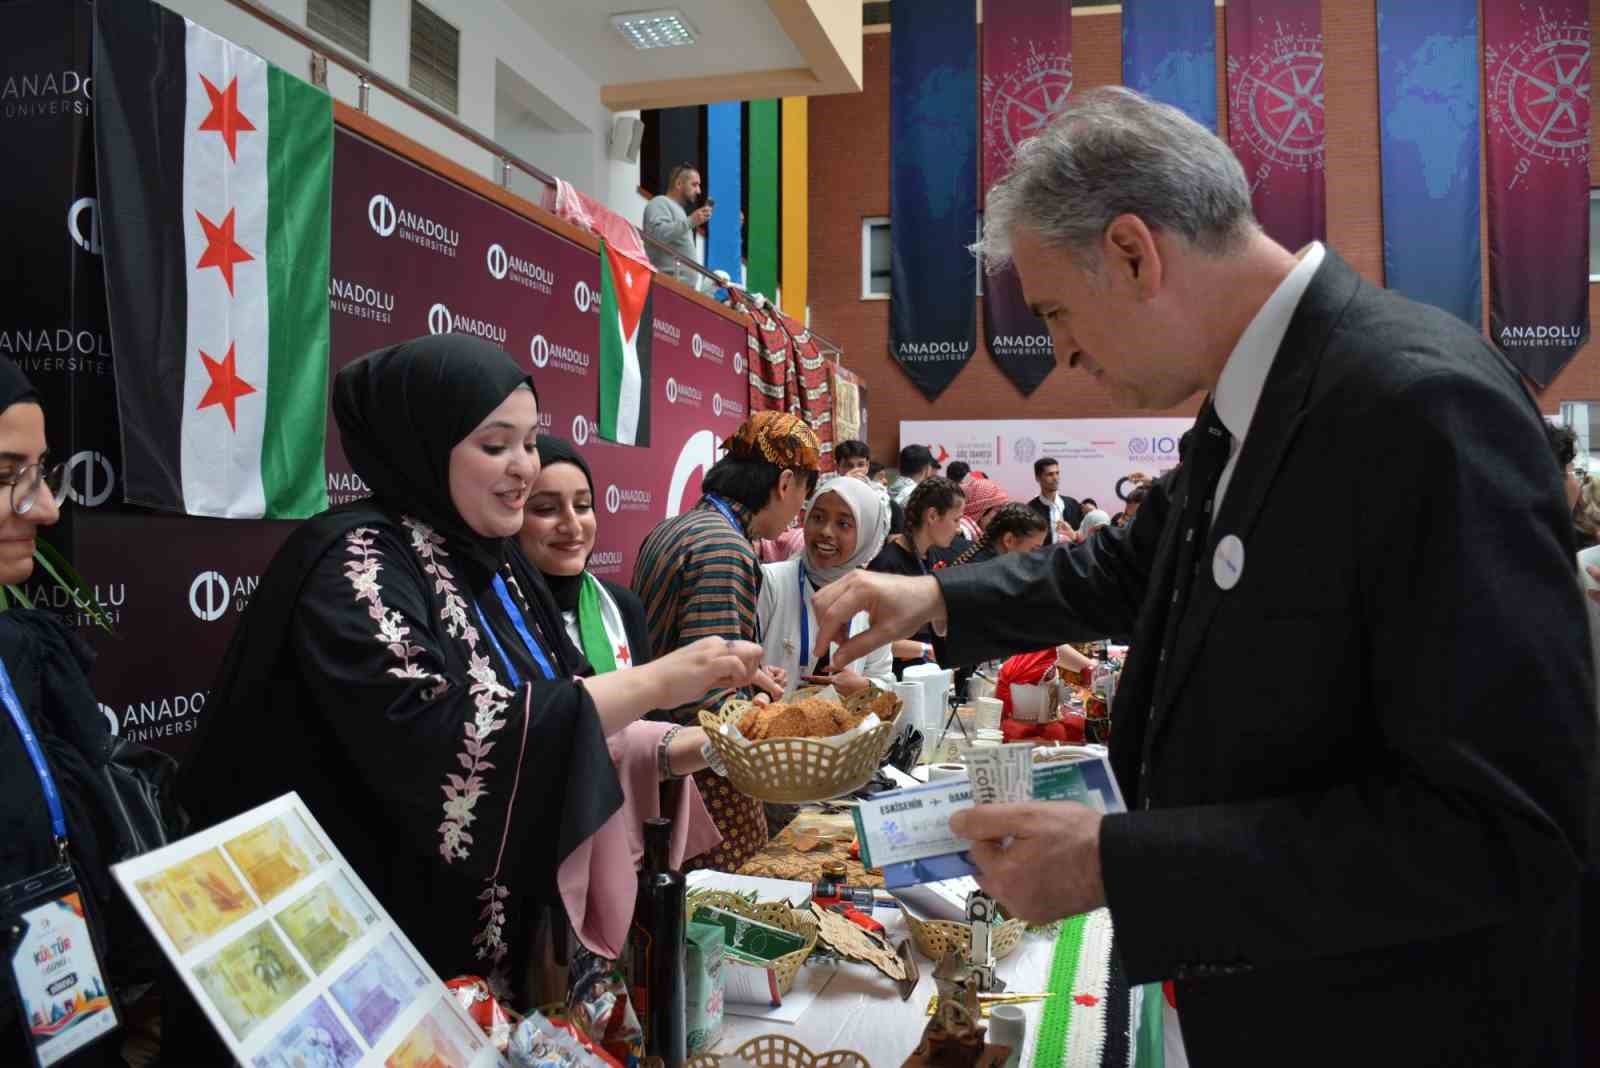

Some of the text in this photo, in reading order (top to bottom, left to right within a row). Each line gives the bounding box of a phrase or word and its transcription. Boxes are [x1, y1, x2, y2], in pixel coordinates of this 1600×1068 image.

[397, 209, 460, 247] ANADOLU
[508, 255, 554, 286] ANADOLU
[453, 314, 507, 343] ANADOLU
[1500, 325, 1581, 338] ANADOLU
[899, 341, 969, 354] ANADOLU
[992, 335, 1054, 348] ANADOL
[1152, 436, 1181, 455] IO
[122, 690, 211, 728] ANADO
